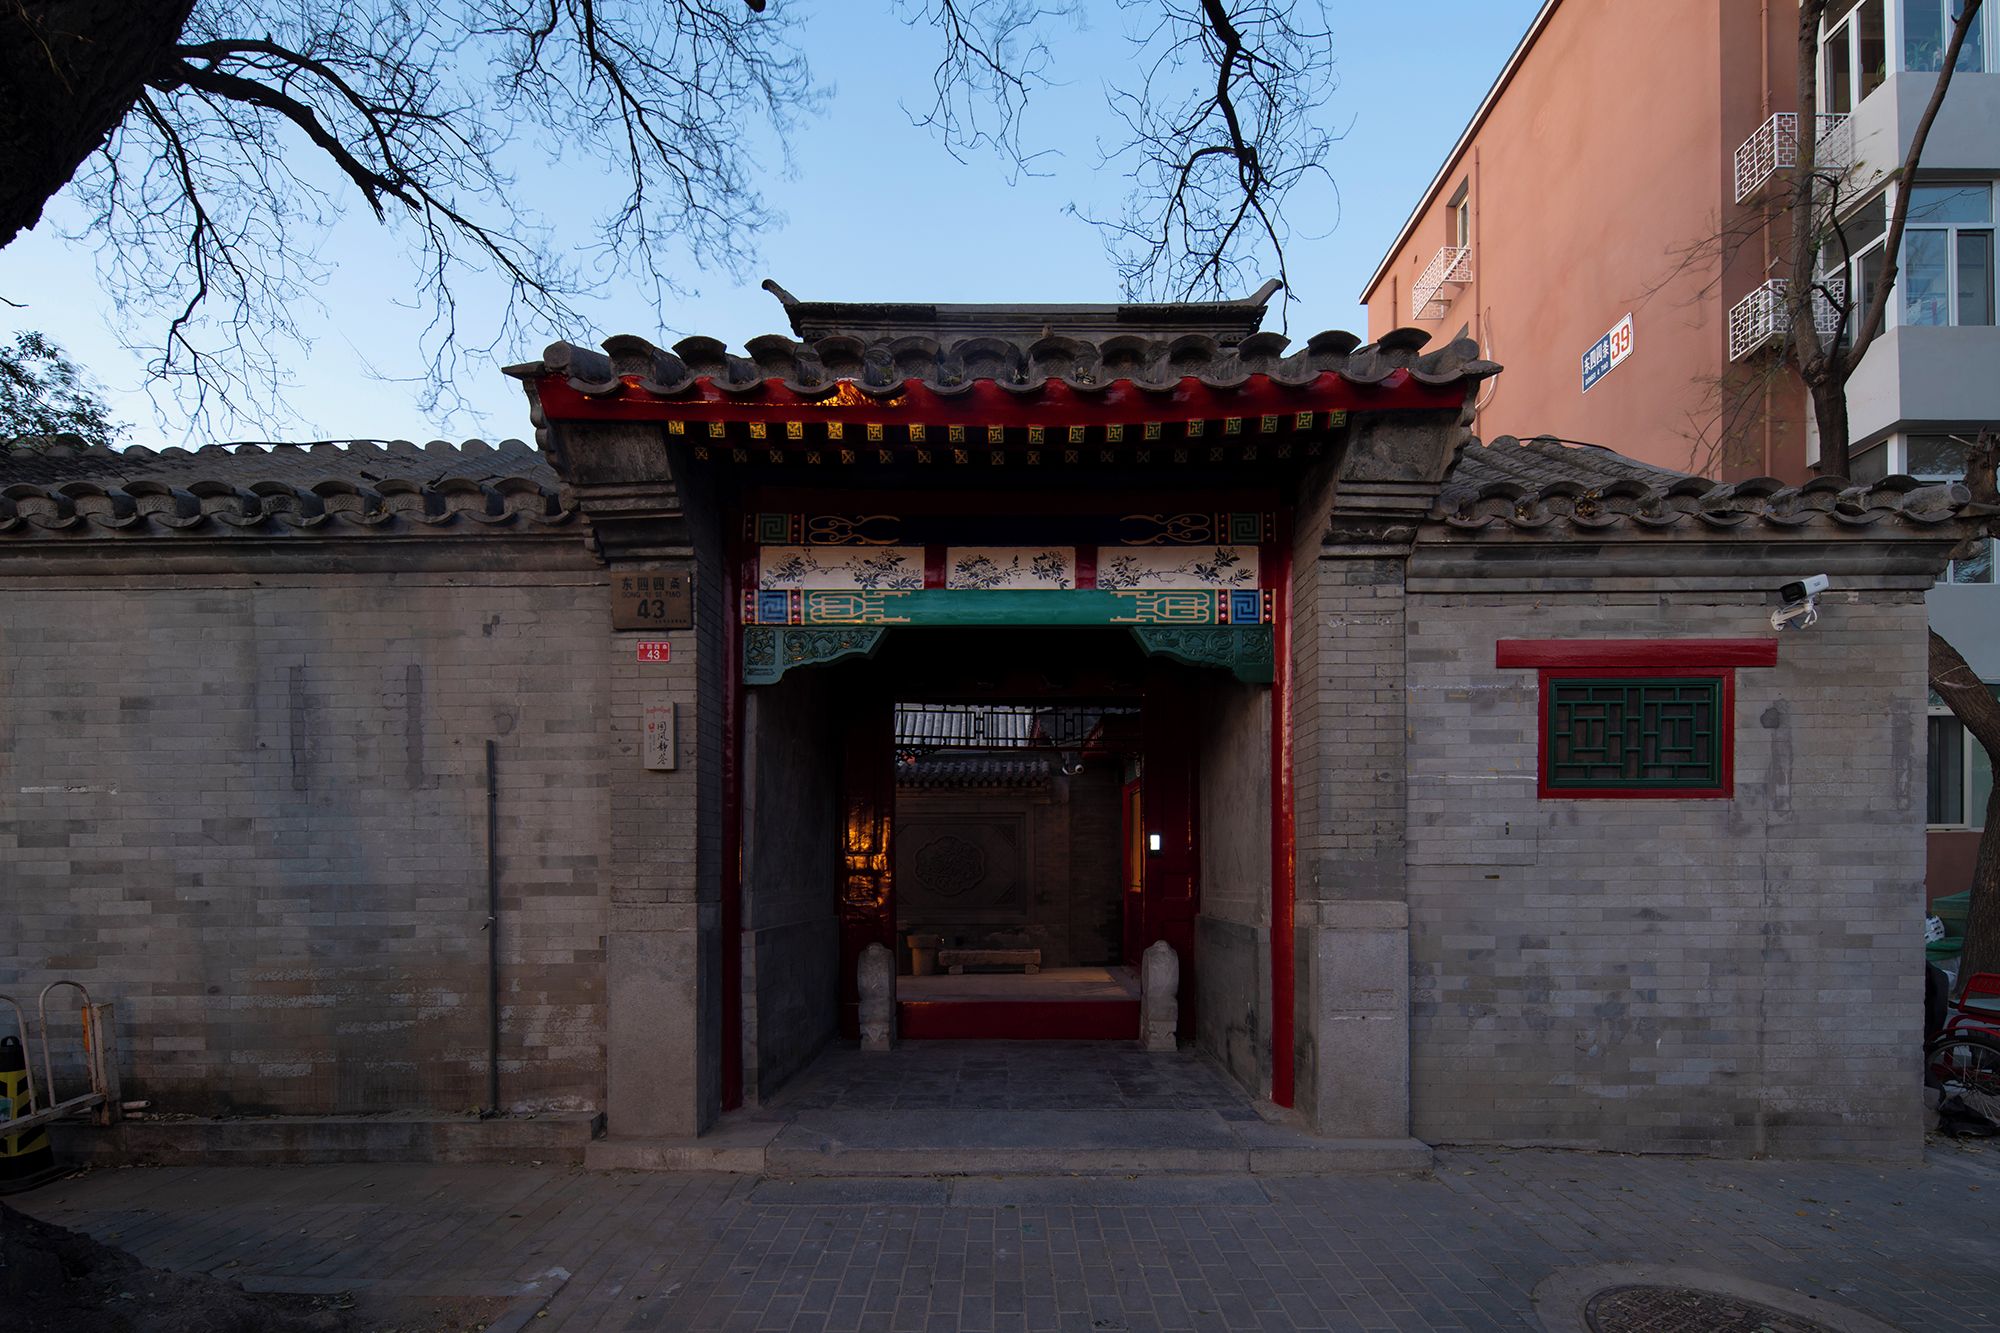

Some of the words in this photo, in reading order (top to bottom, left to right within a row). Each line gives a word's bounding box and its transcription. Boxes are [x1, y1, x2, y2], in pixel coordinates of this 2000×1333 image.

[1611, 323, 1630, 360] 39
[622, 577, 680, 591] 东四四条
[637, 599, 665, 619] 43
[647, 650, 660, 660] 43
